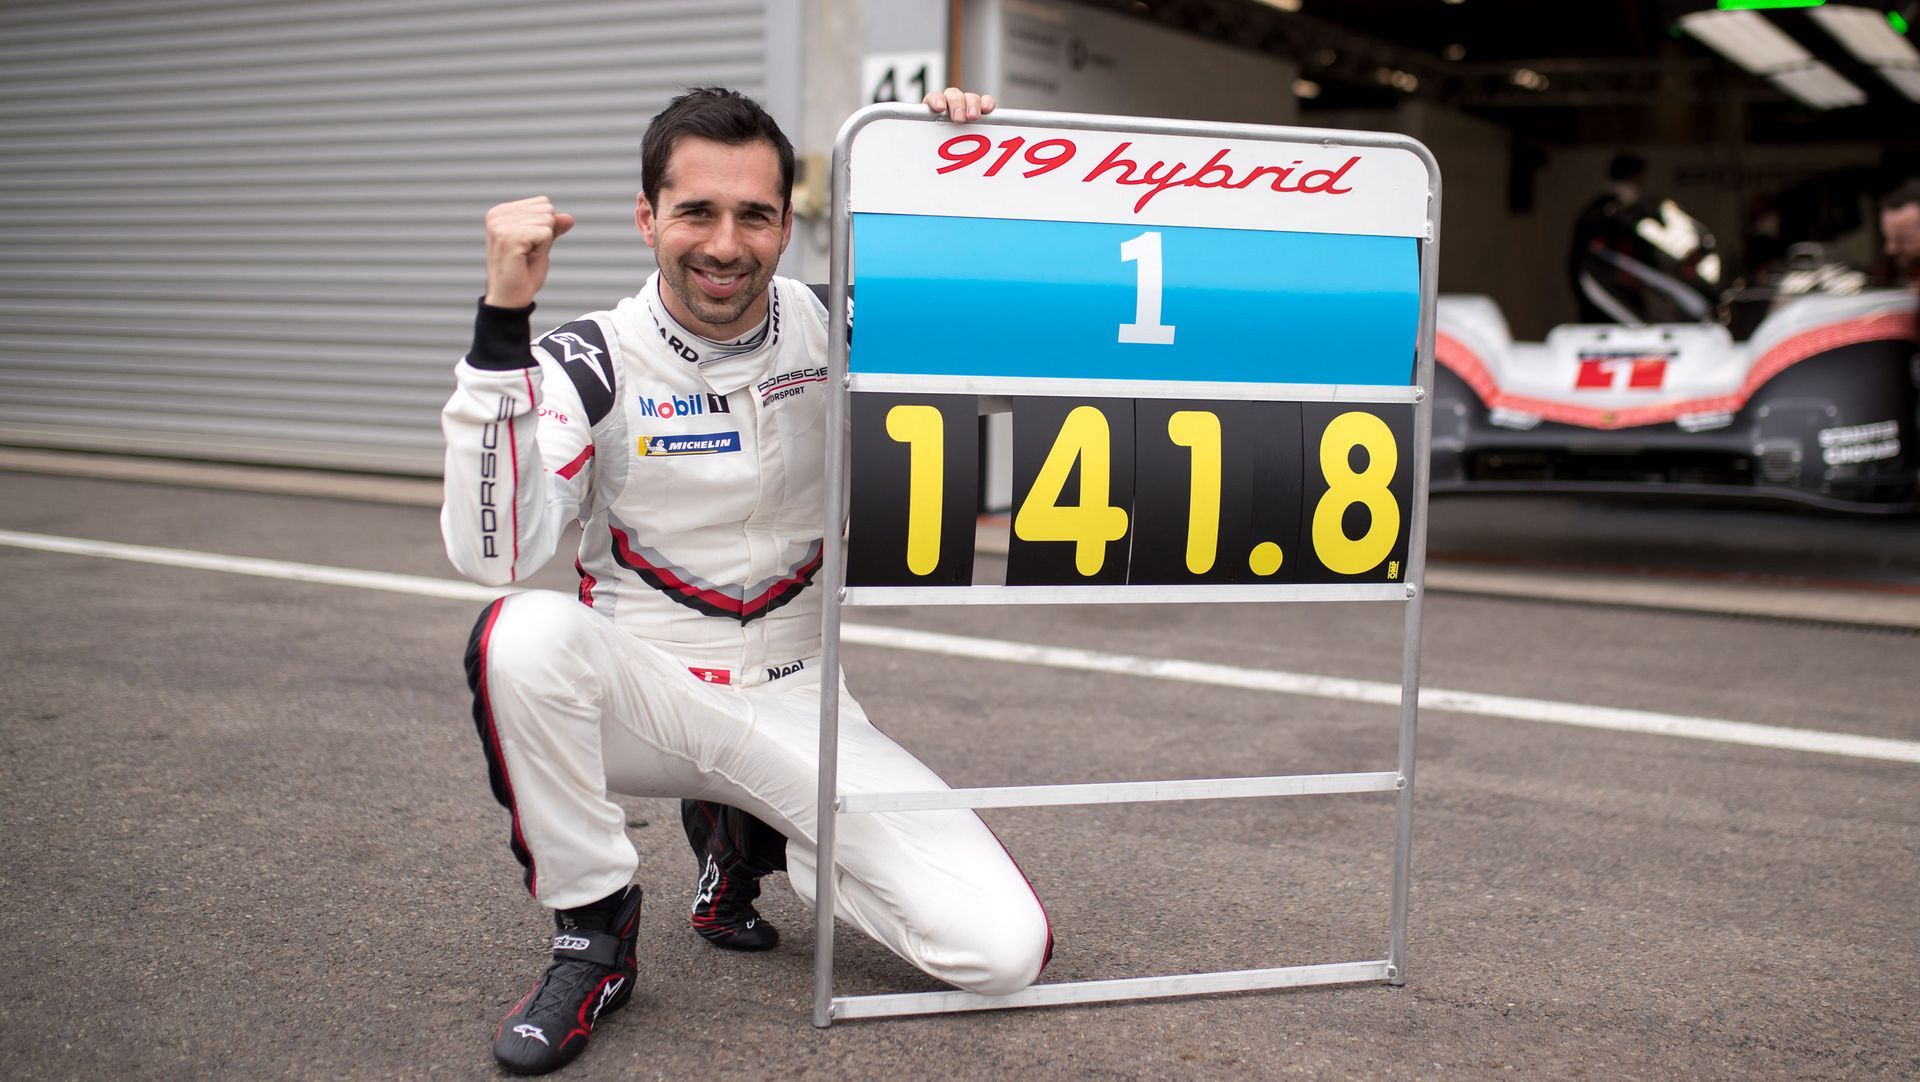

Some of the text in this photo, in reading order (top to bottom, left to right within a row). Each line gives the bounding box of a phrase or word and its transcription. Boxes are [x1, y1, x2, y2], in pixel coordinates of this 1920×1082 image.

[936, 133, 1362, 214] 919 hybrid
[1117, 231, 1176, 345] 1
[639, 394, 703, 419] Mobil
[762, 386, 805, 408] MOTORSPORT
[668, 438, 731, 451] MICHELIN
[480, 396, 516, 559] PORSCE
